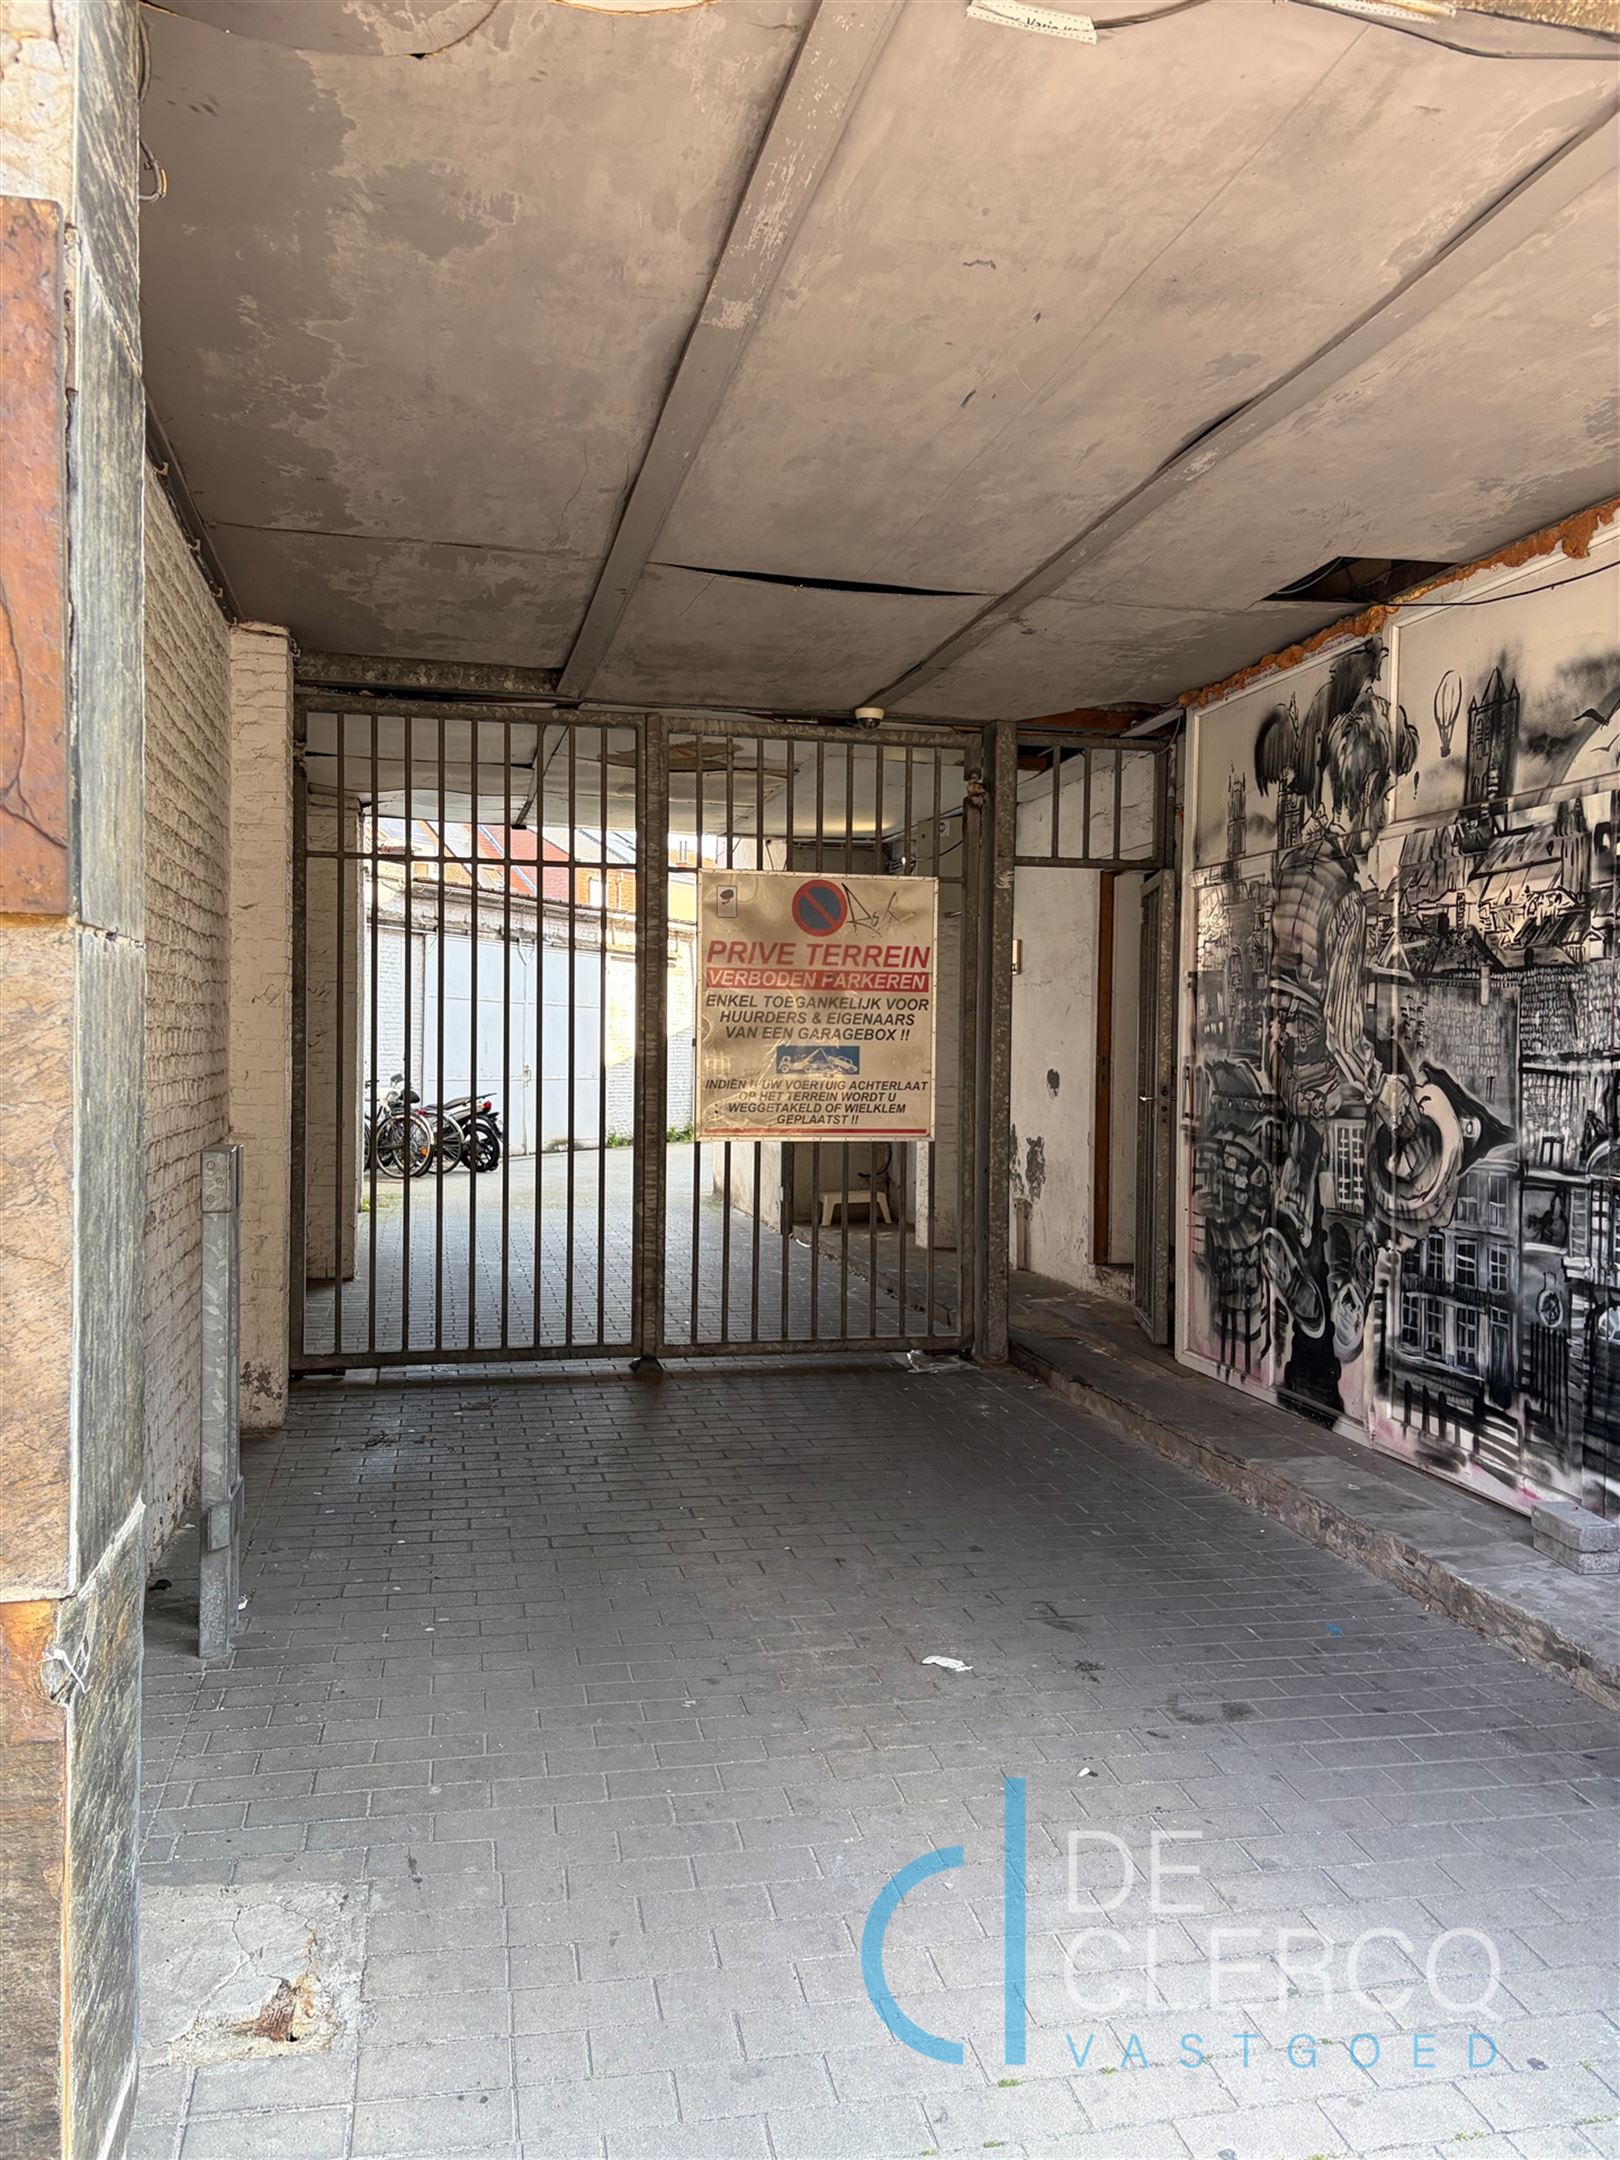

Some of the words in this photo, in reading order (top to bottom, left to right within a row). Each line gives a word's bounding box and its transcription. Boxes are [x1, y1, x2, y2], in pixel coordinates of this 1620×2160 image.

[706, 940, 797, 966] PRIVE
[805, 943, 931, 969] TERREIN
[709, 970, 817, 988] VERBODEN
[821, 973, 926, 990] PARKEREN
[705, 994, 758, 1008] ENKEL
[763, 995, 881, 1011] TOEGANKELIJK
[887, 998, 929, 1011] VOOR
[720, 1010, 807, 1024] HUURDERS
[812, 1012, 822, 1024] &
[826, 1012, 915, 1026] EIGENAARS
[725, 1026, 759, 1039] VAN
[762, 1026, 794, 1040] EEN
[798, 1027, 896, 1041] GARAGEBOX
[900, 1028, 911, 1041] !!
[762, 1080, 782, 1090] UW
[785, 1080, 846, 1091] VOERTUIG
[848, 1081, 929, 1091] ACHTERLAAT
[739, 1091, 756, 1101] OP
[759, 1091, 784, 1101] HET
[787, 1091, 838, 1101] TERREIN
[841, 1092, 885, 1102] WORDT
[888, 1092, 897, 1102] U
[728, 1102, 822, 1113] WEGGETAKELD
[824, 1103, 842, 1113] OF
[844, 1103, 907, 1114] WIELKLEM
[776, 1114, 849, 1125] GEPLAATST
[850, 1115, 859, 1125] !!
